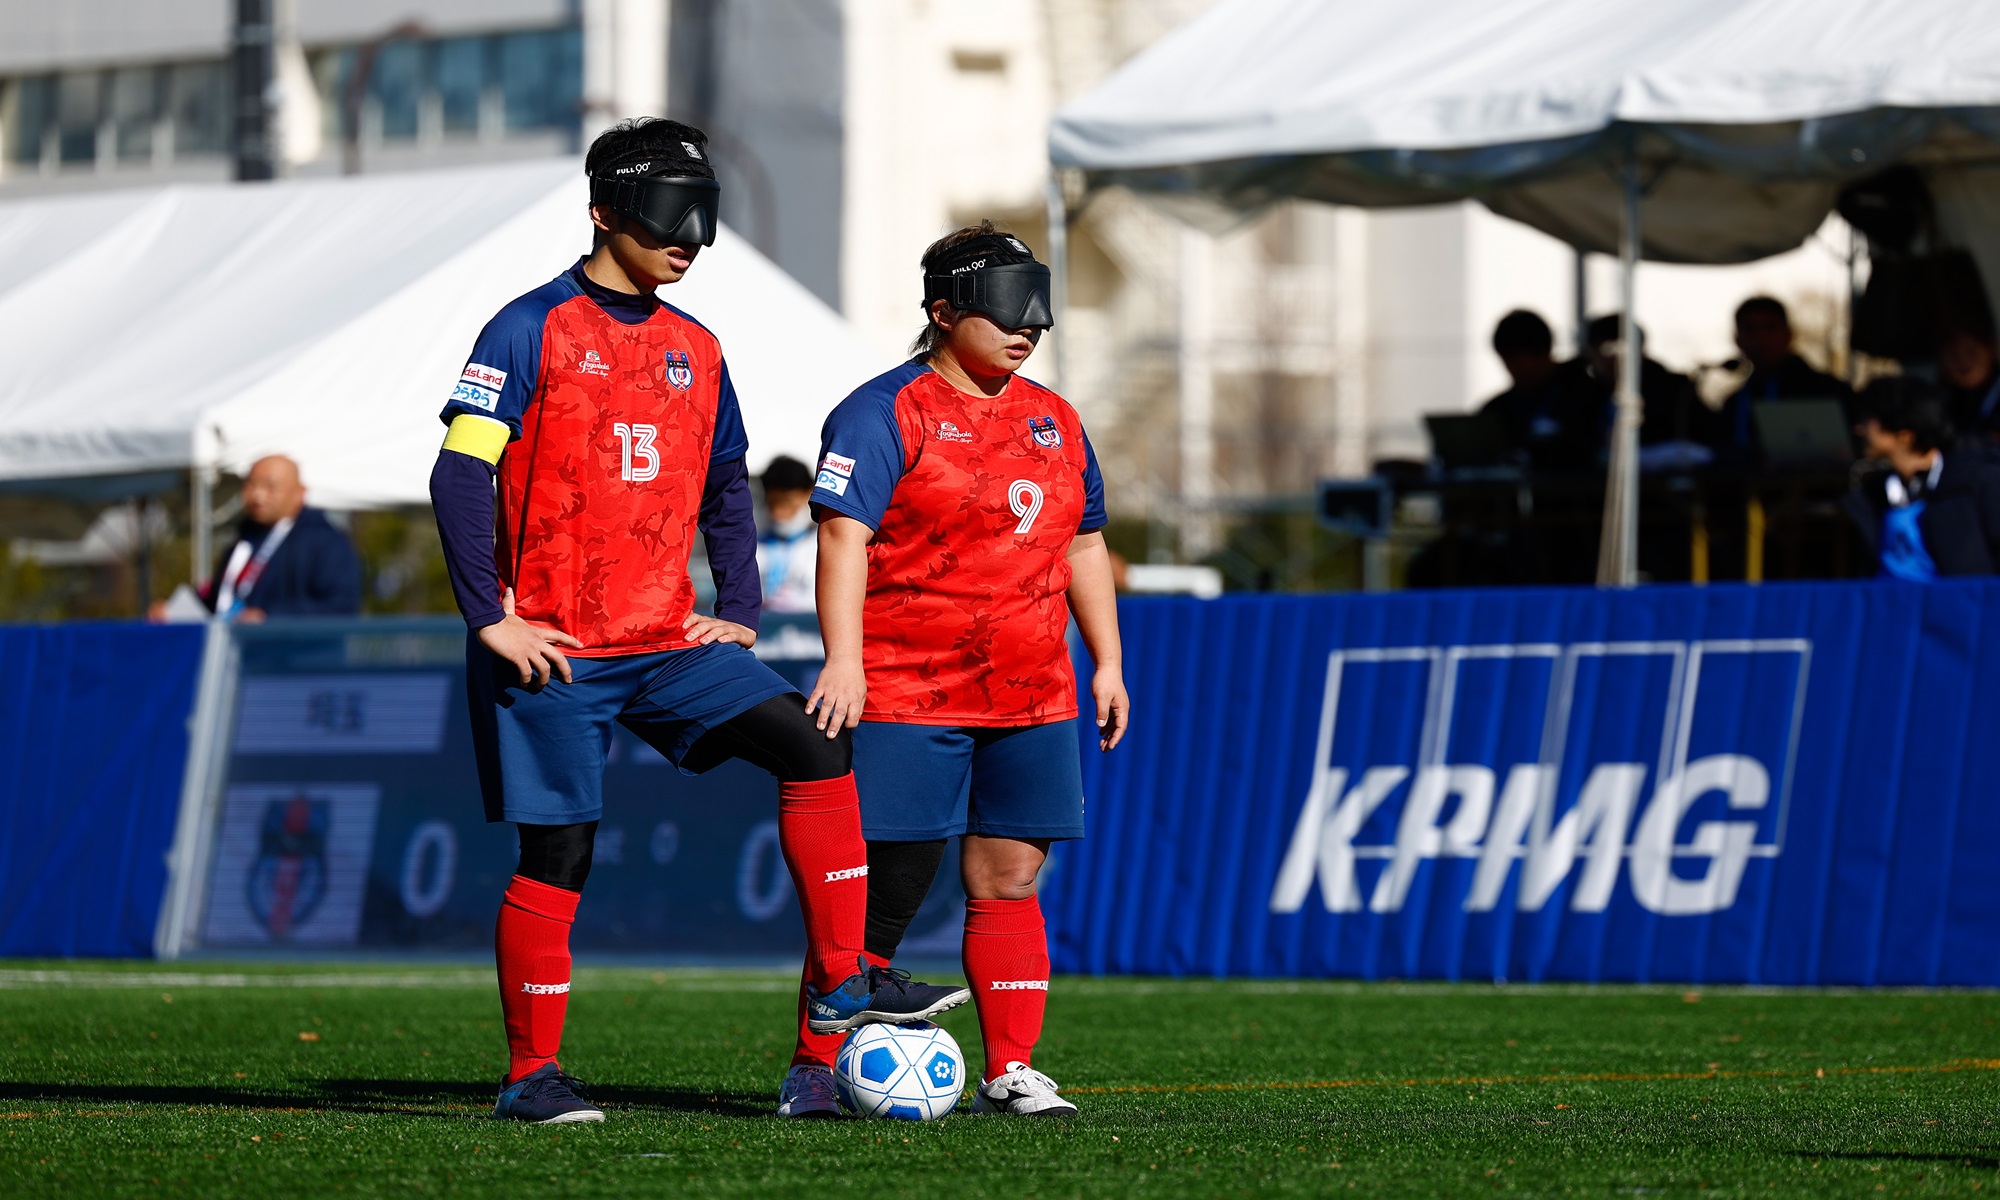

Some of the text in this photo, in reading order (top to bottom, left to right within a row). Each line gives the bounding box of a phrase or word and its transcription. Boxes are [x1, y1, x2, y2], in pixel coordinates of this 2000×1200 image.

[613, 422, 661, 482] 13
[1008, 479, 1044, 534] 9
[402, 821, 457, 918] 0
[735, 820, 791, 922] 0
[1269, 753, 1771, 917] KPMG
